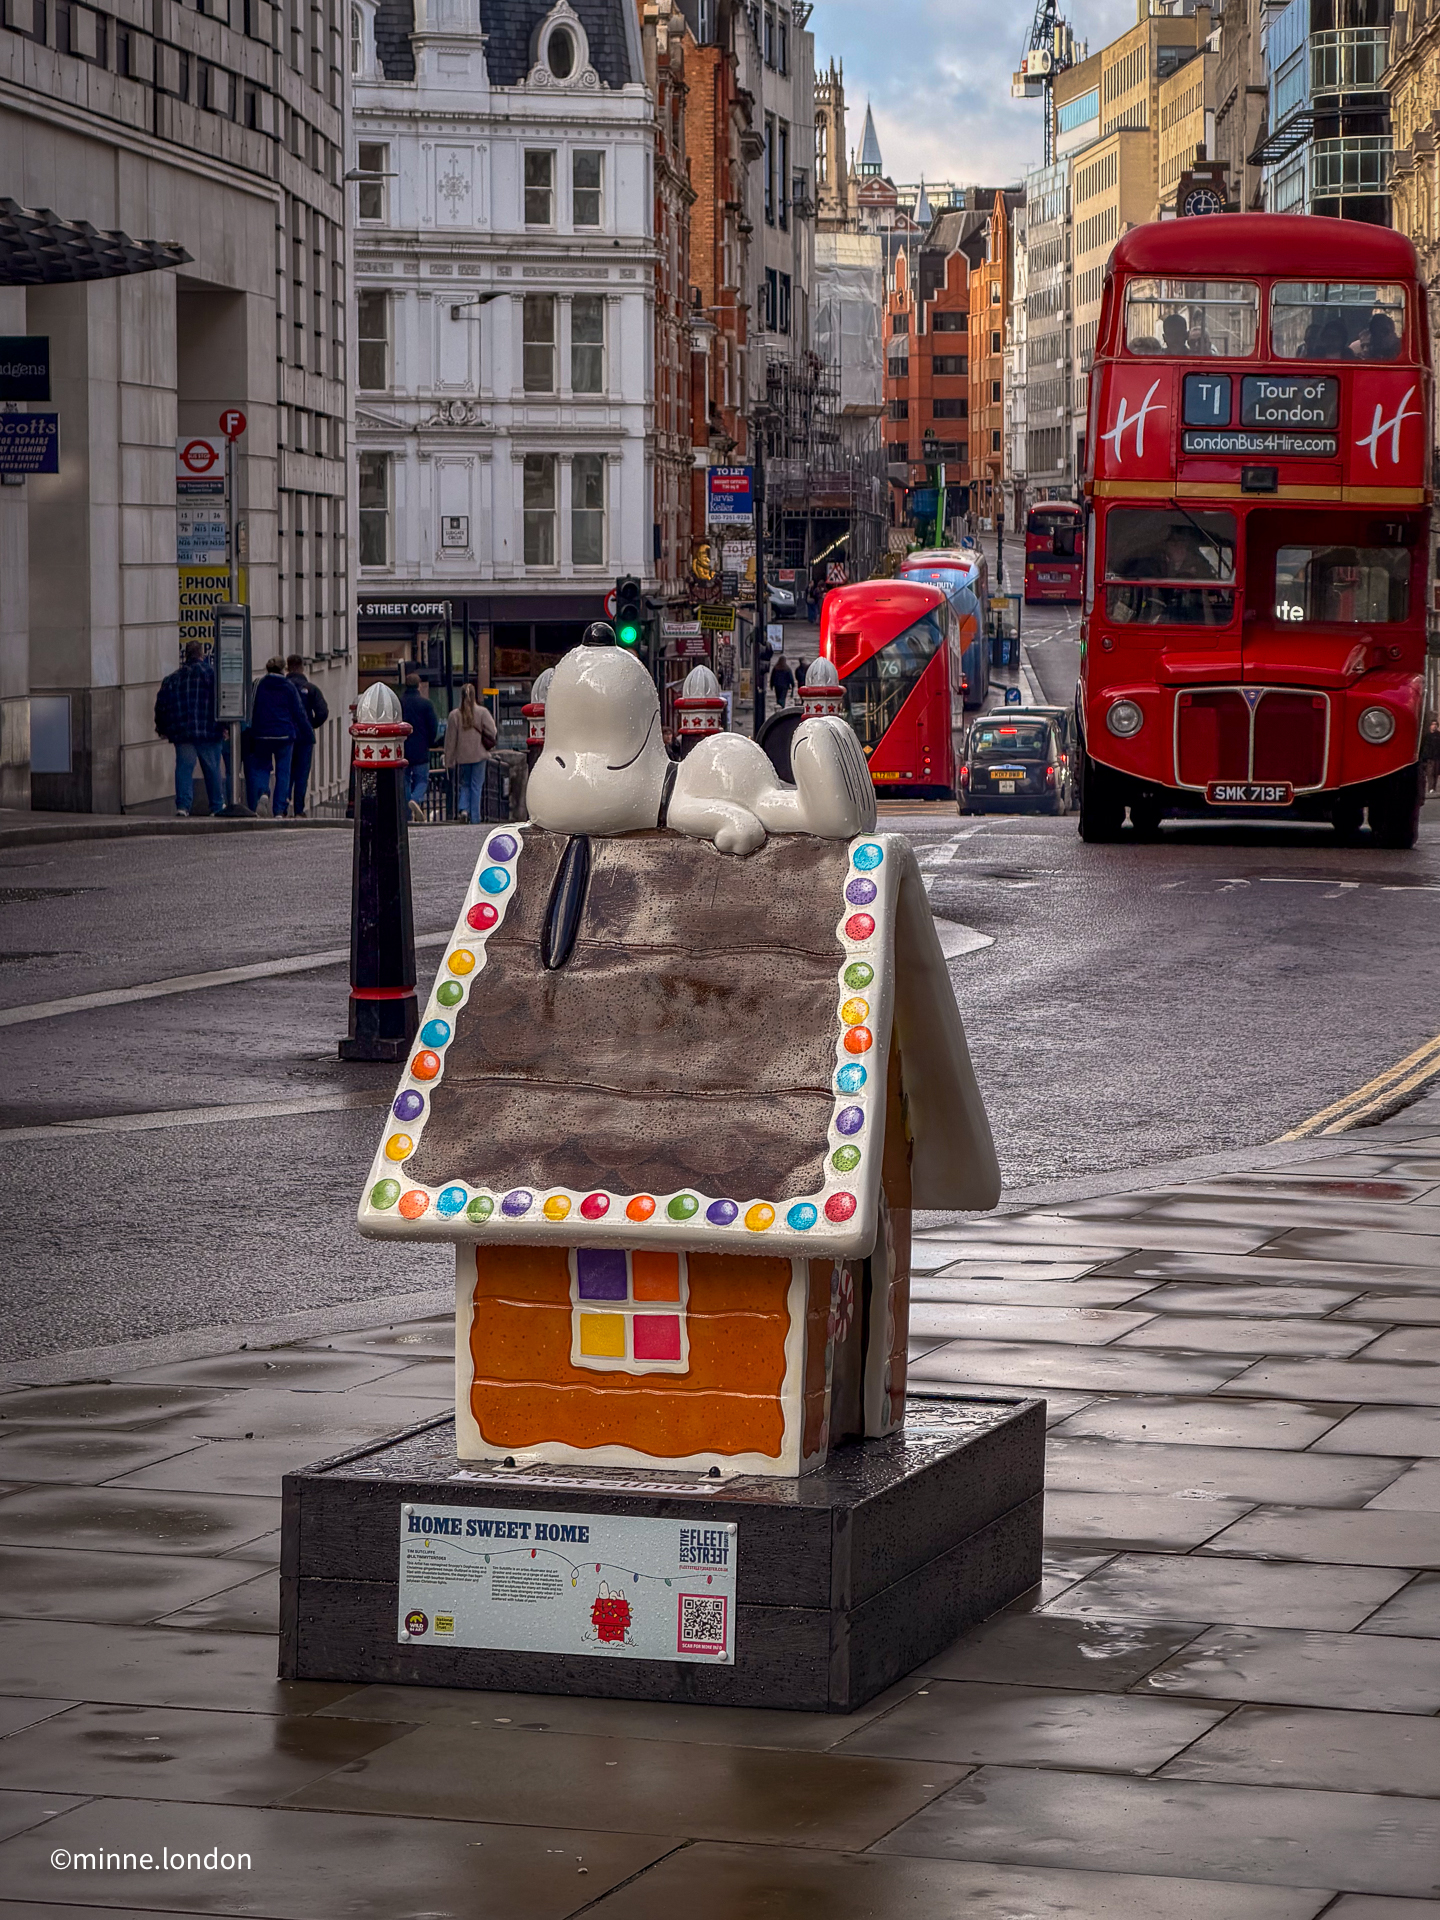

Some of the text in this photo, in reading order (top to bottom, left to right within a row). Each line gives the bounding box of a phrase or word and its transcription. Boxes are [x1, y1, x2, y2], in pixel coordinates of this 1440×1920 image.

[1257, 382, 1325, 398] Tour of
[1198, 384, 1220, 415] T1
[1256, 405, 1324, 421] London
[226, 413, 239, 433] F
[1186, 434, 1336, 450] LondonBus4Hire.com
[711, 493, 734, 502] Jarvis
[710, 502, 734, 512] Keller
[186, 576, 230, 588] PHON
[366, 603, 408, 615] STREET
[179, 625, 215, 638] SORI
[881, 660, 898, 679] 76
[1215, 786, 1286, 801] SMK 713F
[600, 1482, 698, 1490] climb
[408, 1516, 589, 1543] HOME SWEET HOME
[680, 1529, 689, 1562] FESTIVE
[690, 1529, 723, 1547] FLEET
[690, 1546, 729, 1564] STREET
